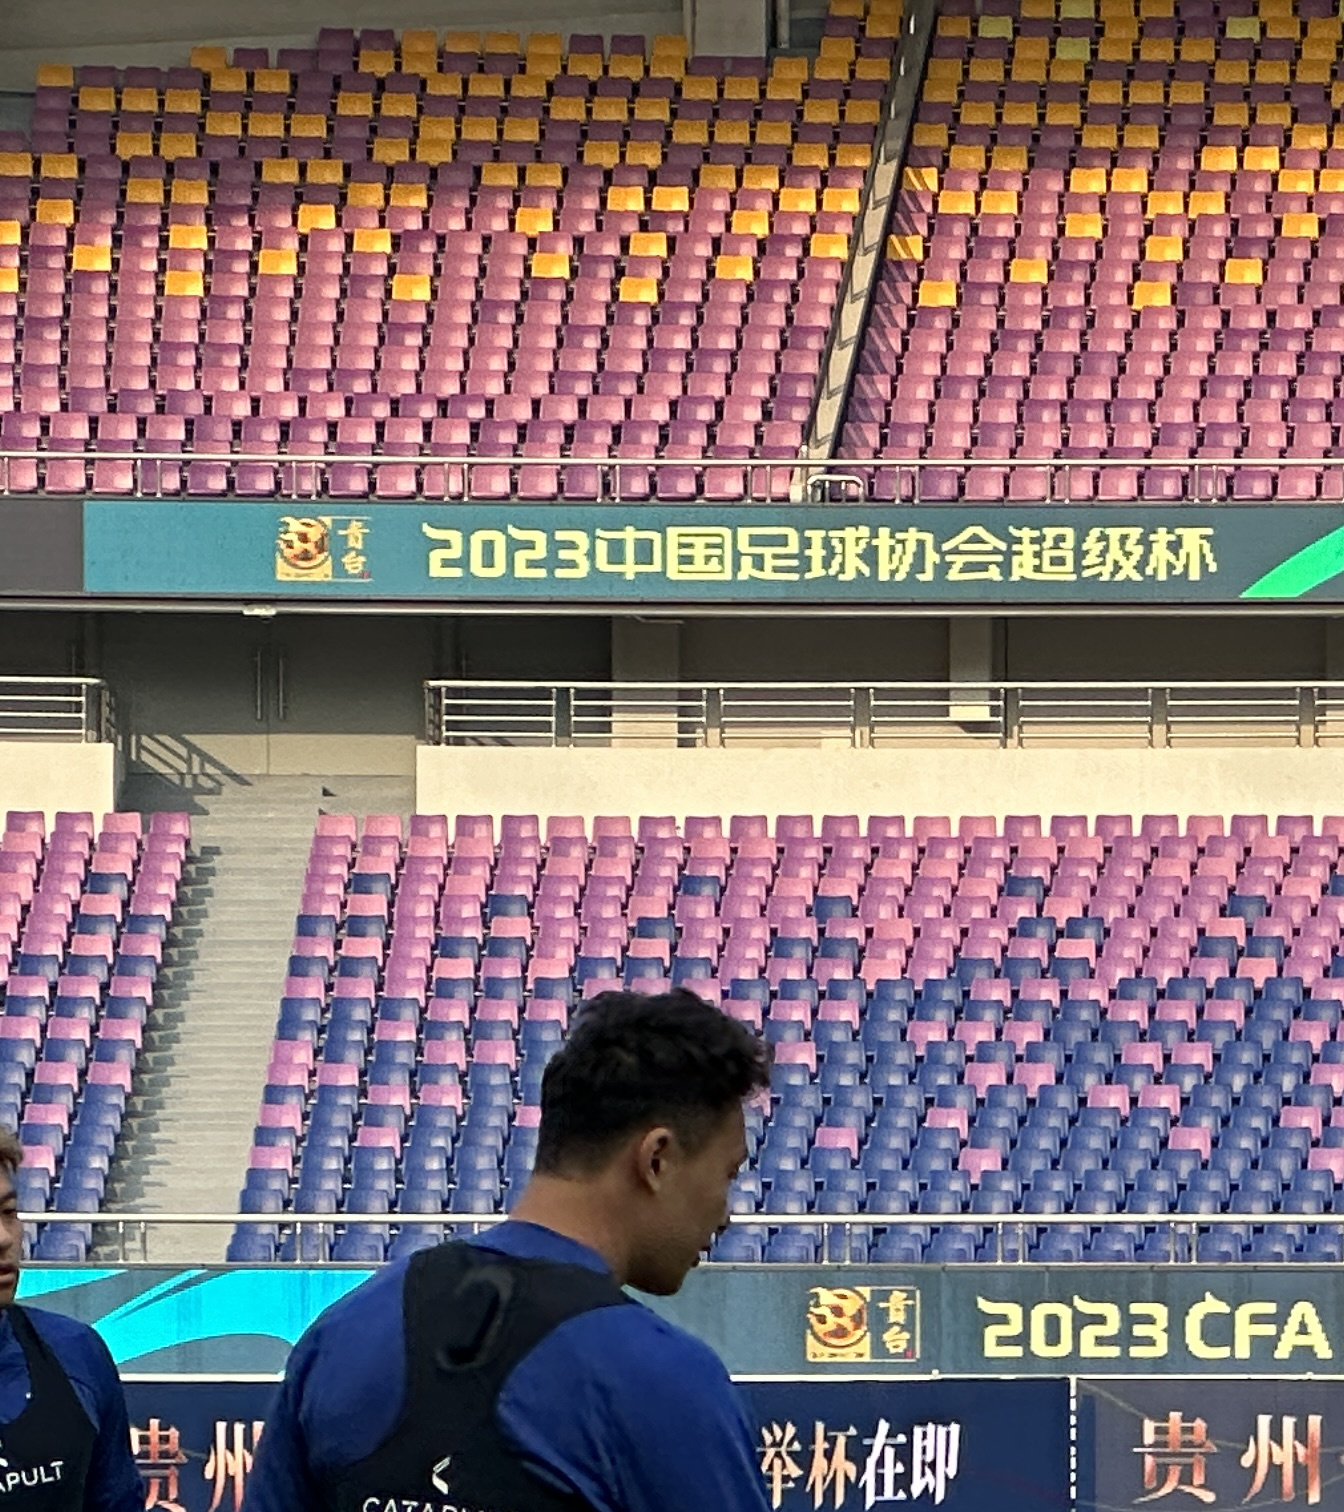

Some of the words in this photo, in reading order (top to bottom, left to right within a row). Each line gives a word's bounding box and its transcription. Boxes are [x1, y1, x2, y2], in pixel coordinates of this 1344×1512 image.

[423, 522, 1218, 582] 2023中国足球协会超级杯
[976, 1295, 1168, 1358] 2023
[1185, 1291, 1333, 1360] CFA
[756, 1418, 960, 1510] 举杯在即
